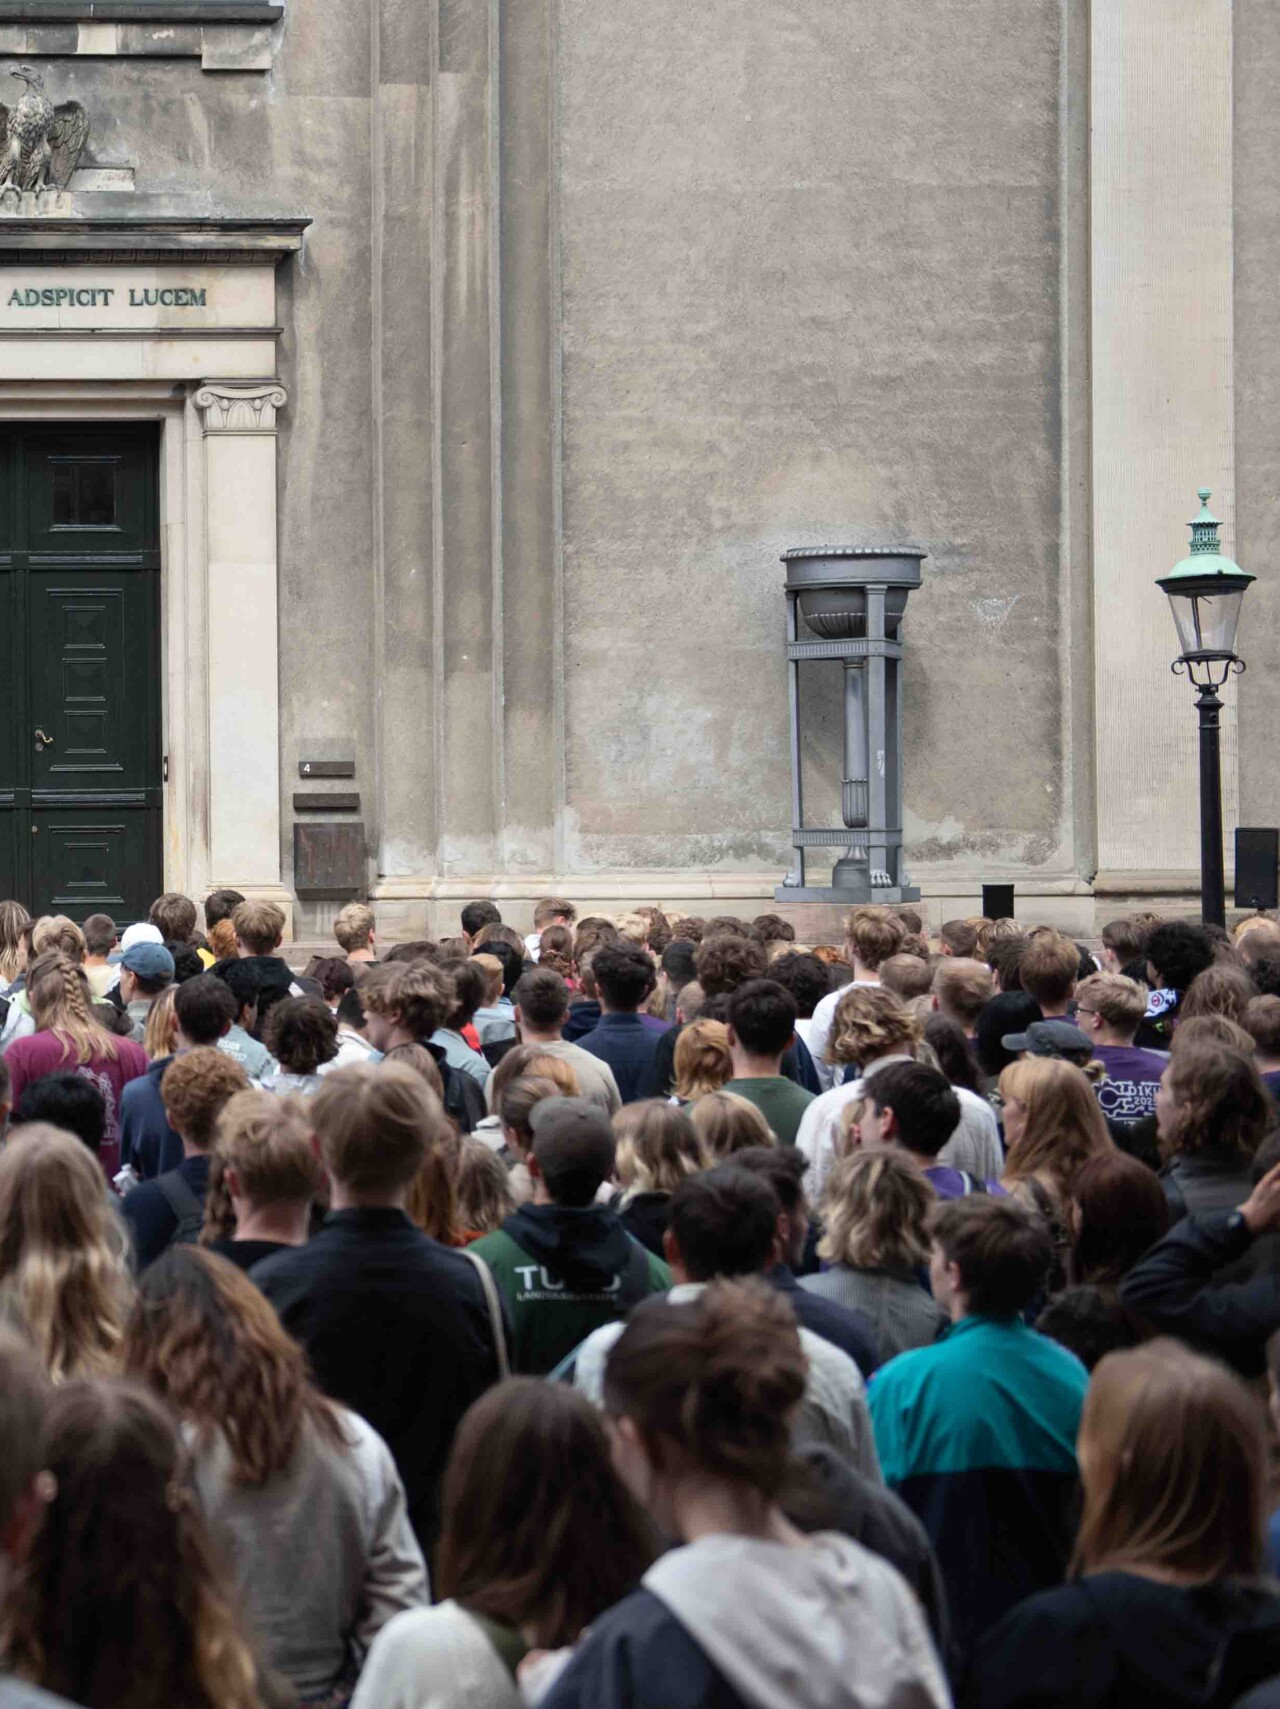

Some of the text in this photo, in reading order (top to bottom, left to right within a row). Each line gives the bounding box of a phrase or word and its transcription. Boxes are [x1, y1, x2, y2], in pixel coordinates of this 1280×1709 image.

[7, 288, 114, 307] ADSPICIT
[130, 288, 206, 307] LUCEM
[303, 764, 311, 773] 4
